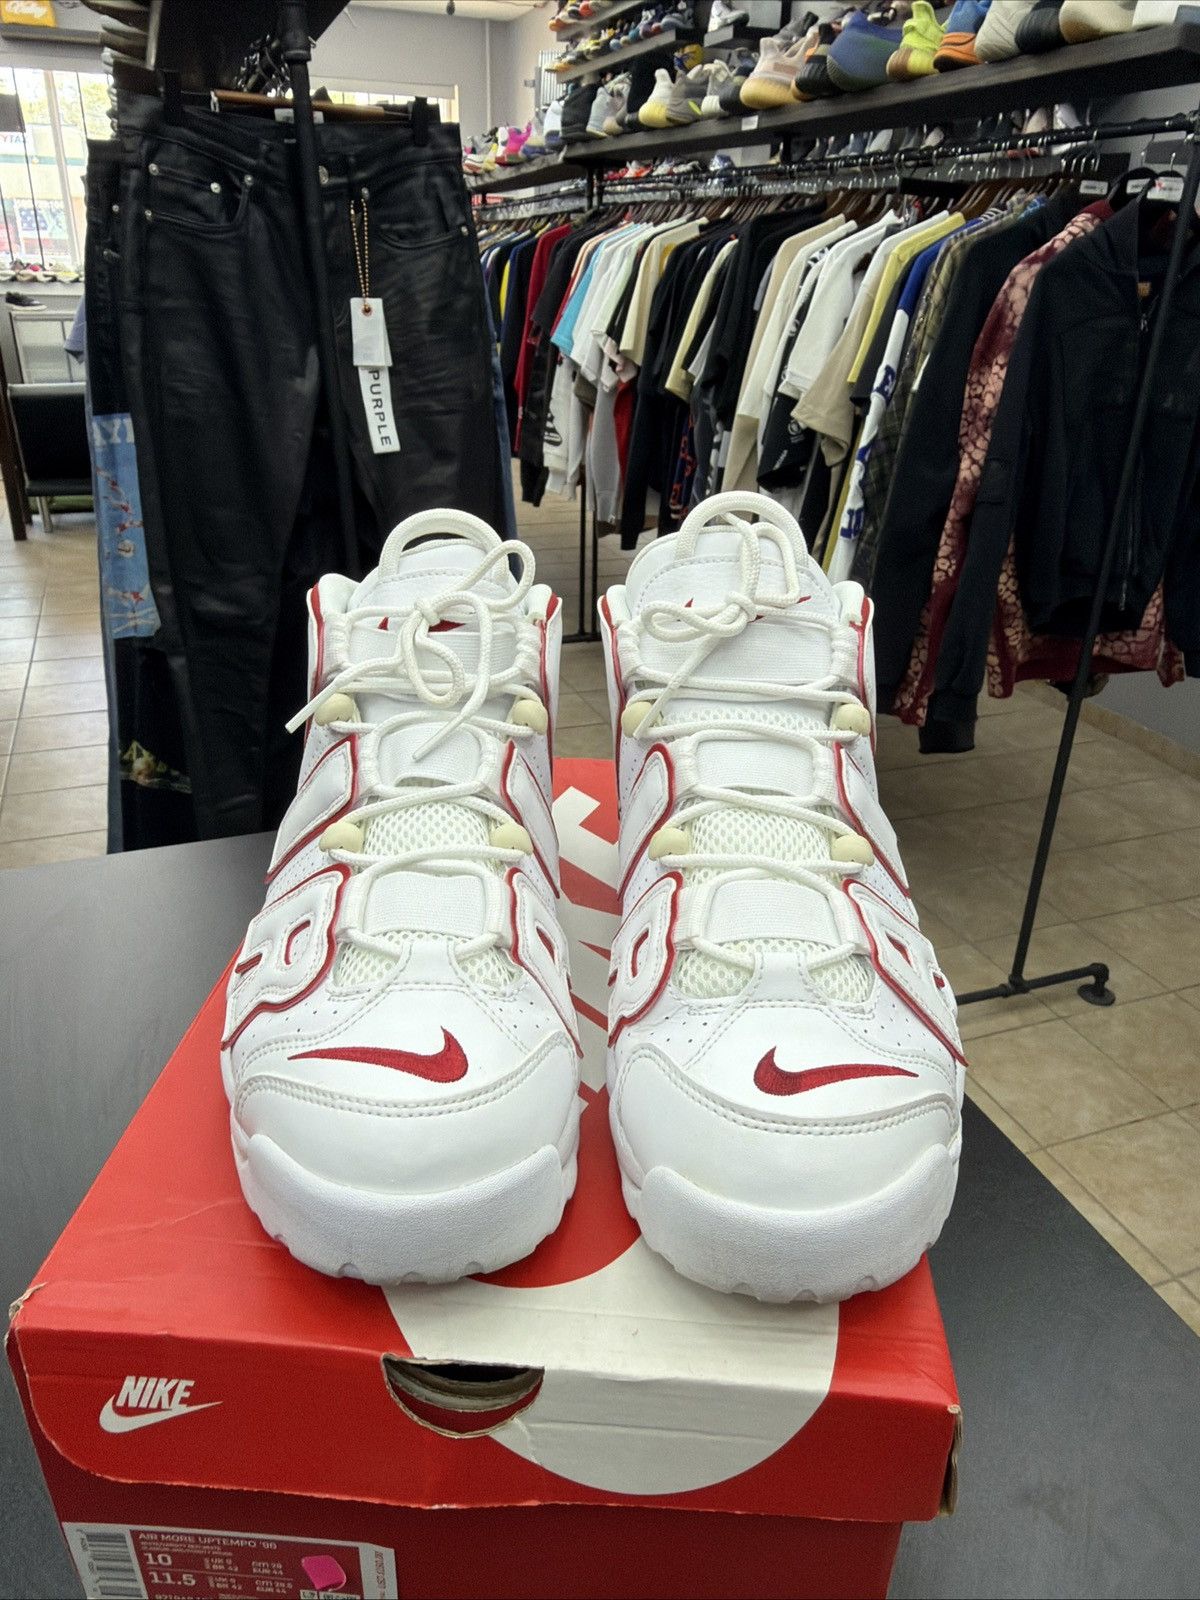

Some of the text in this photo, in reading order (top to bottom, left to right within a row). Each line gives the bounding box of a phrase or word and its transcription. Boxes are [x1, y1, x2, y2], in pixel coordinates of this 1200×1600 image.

[368, 370, 392, 446] PURPLE
[115, 1375, 196, 1411] NIKE
[139, 1532, 157, 1540] AIR
[161, 1534, 195, 1543] MORE
[199, 1536, 256, 1548] UPTEMPO
[143, 1552, 173, 1567] 10
[148, 1571, 196, 1586] 11.5
